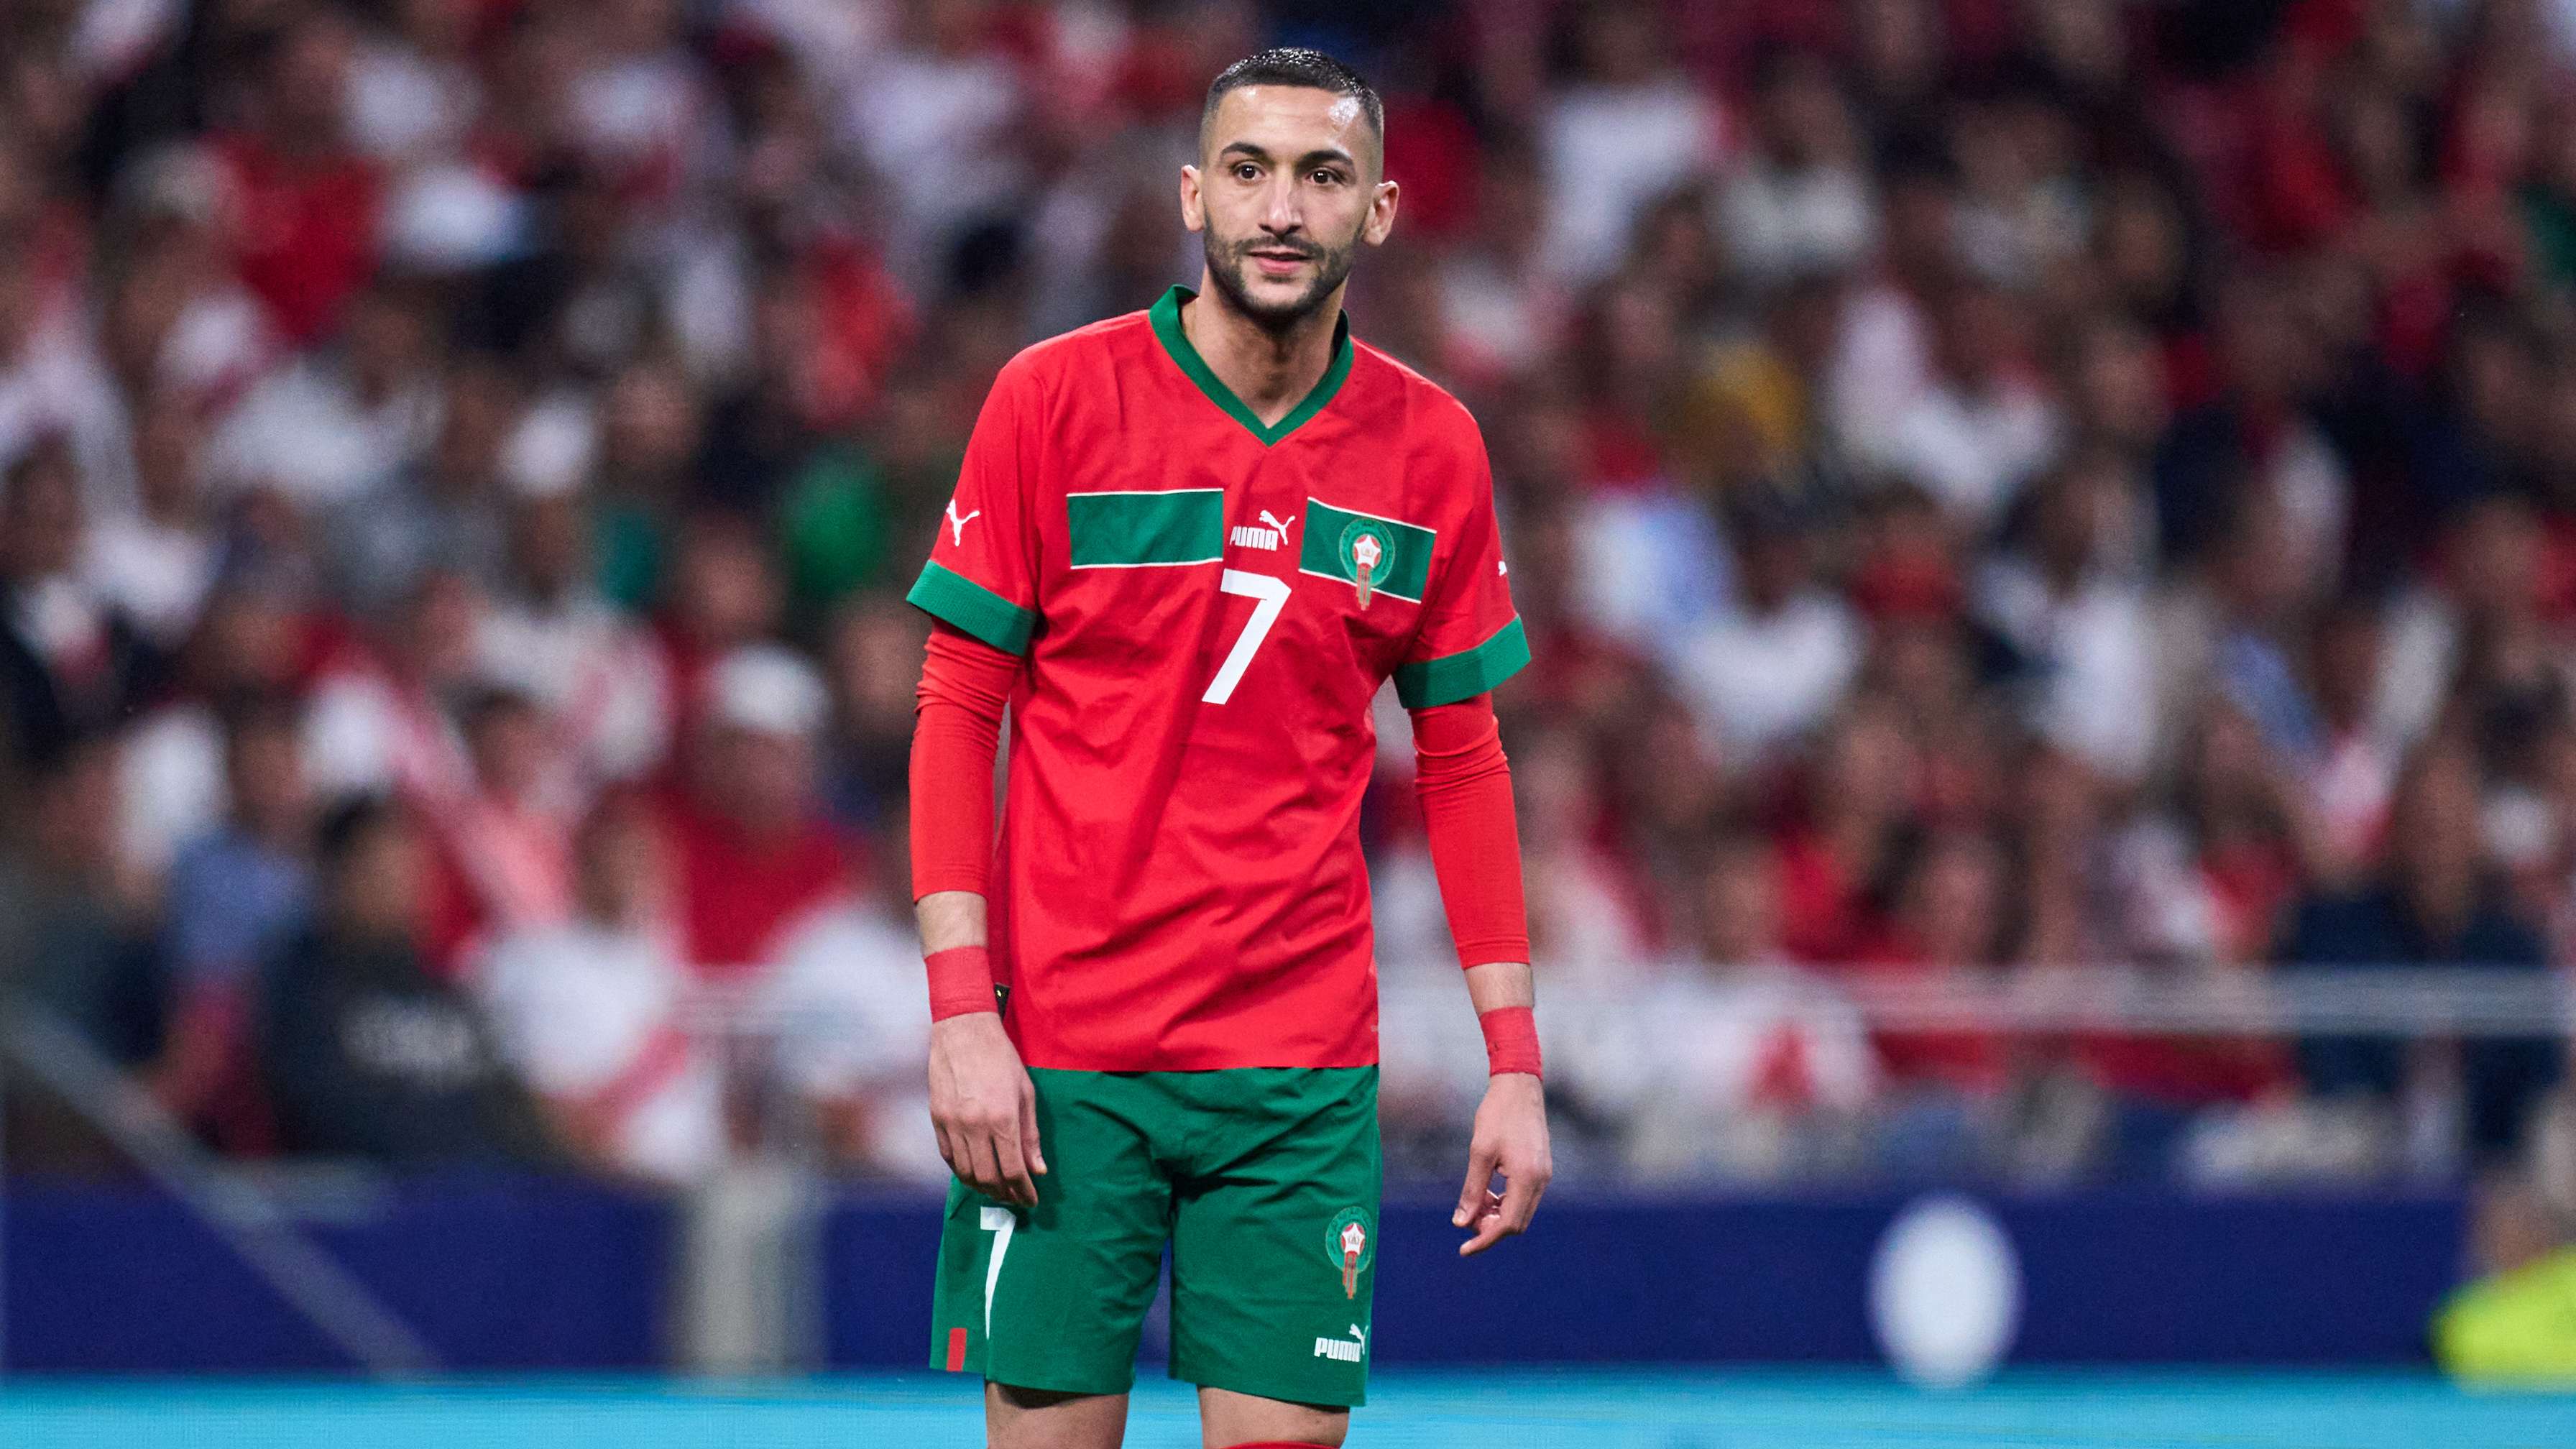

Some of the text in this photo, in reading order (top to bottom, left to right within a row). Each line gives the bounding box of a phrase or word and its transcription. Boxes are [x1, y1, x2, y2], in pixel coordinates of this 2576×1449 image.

[1230, 525, 1279, 551] PUMA
[1201, 568, 1292, 705] 7
[980, 1206, 1017, 1340] 7
[1314, 1337, 1361, 1362] PUMA
